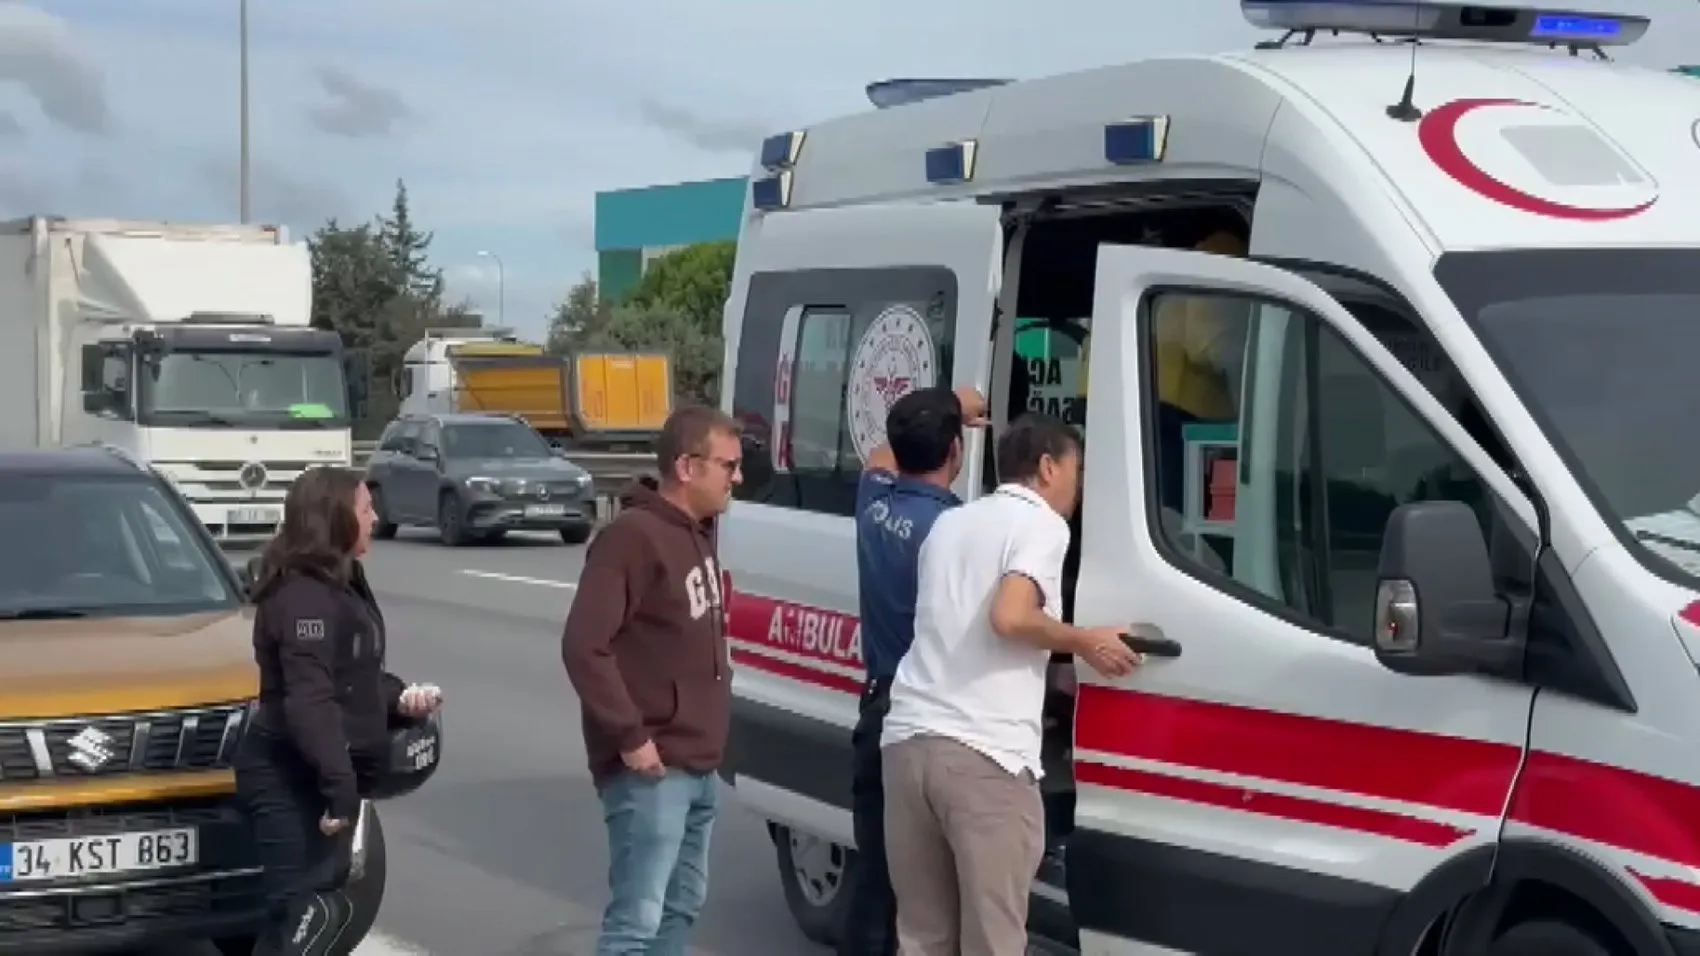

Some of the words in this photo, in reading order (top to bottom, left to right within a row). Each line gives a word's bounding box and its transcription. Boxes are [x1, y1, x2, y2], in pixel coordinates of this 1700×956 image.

[17, 844, 51, 877] 34
[69, 839, 122, 873] KST
[138, 832, 189, 865] 863
